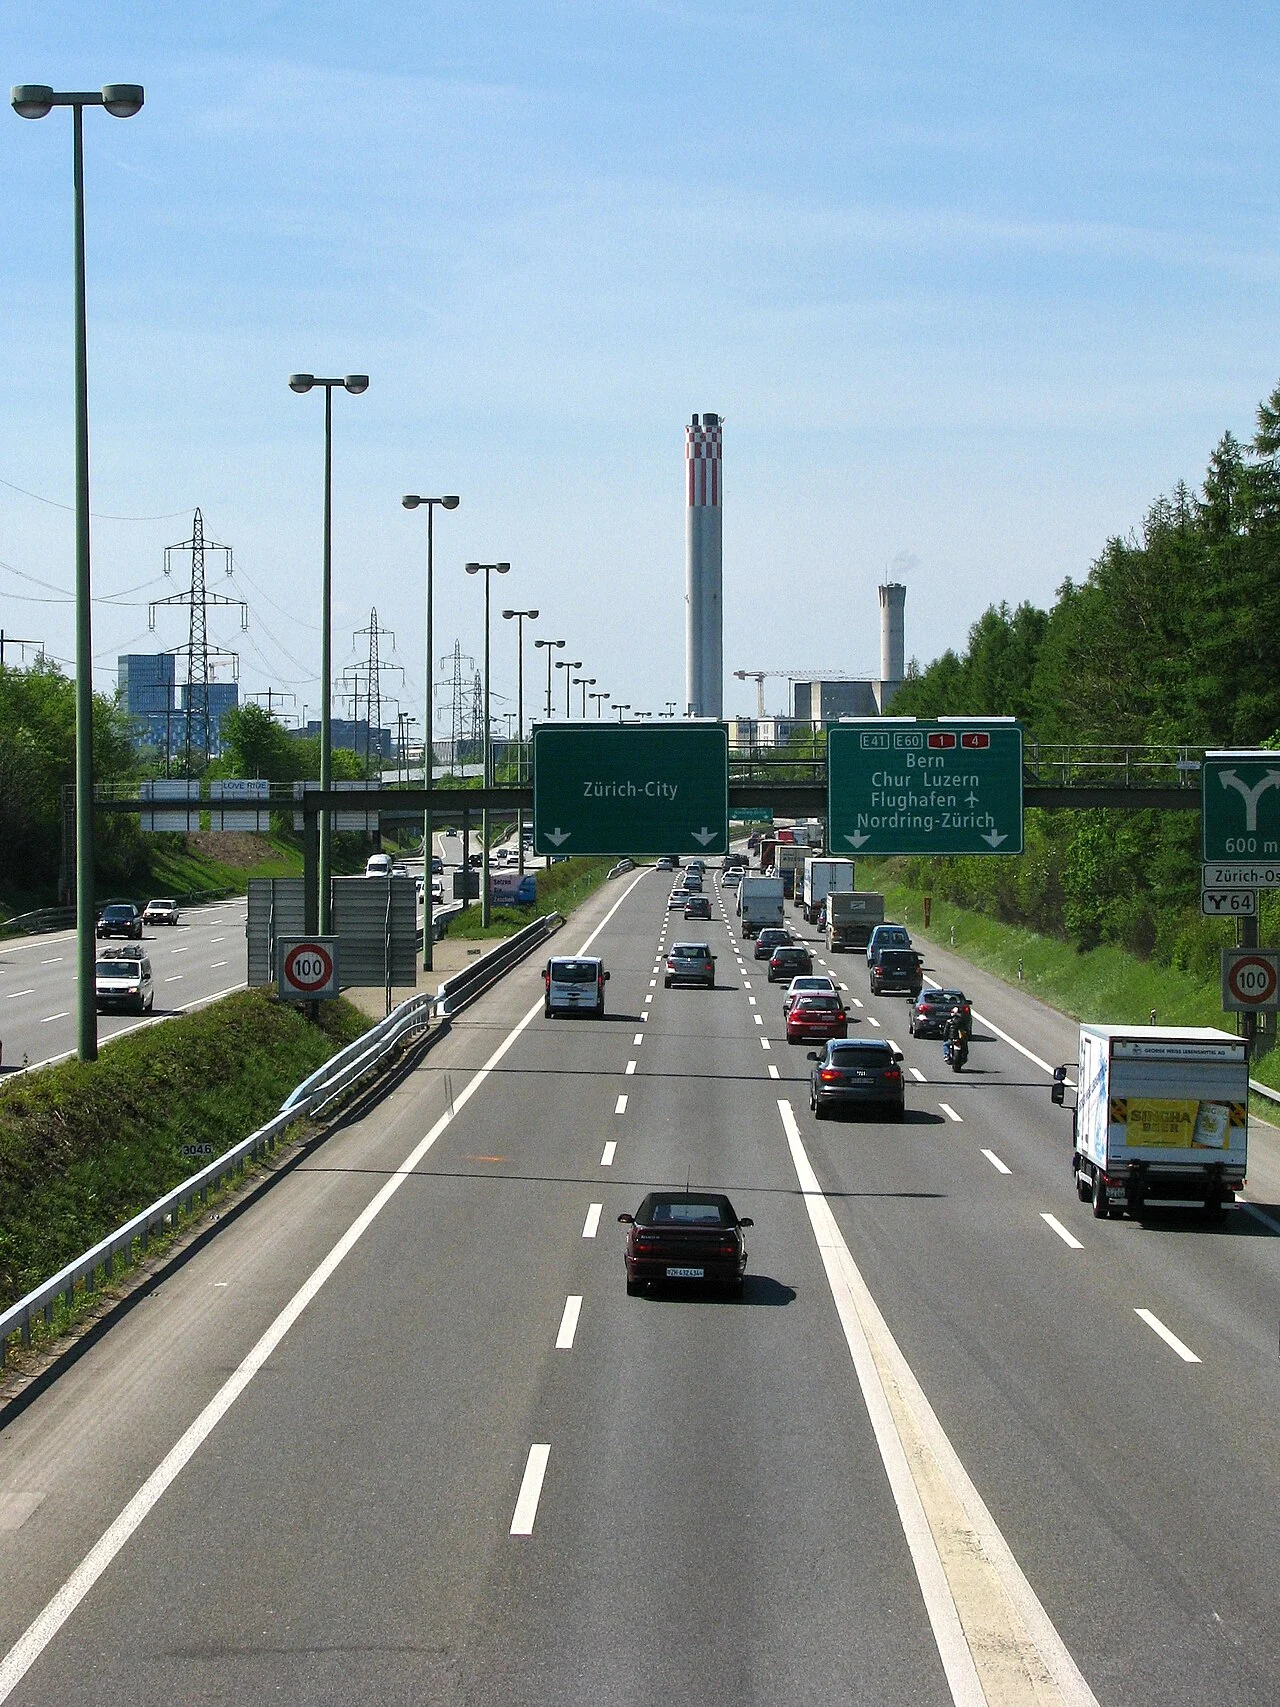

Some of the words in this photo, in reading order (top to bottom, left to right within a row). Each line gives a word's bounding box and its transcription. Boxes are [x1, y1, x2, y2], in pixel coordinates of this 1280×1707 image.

[863, 735, 884, 747] E41
[896, 735, 919, 747] E60
[971, 735, 979, 747] 4
[906, 753, 944, 768] Bern
[223, 781, 245, 790] LOVE
[247, 781, 267, 789] RIDE
[871, 771, 911, 787] Chur
[923, 771, 979, 787] Luzern
[583, 781, 678, 800] Zürich-City
[871, 791, 956, 811] Flughafen
[857, 813, 994, 832] Nordring-Zürich
[1225, 838, 1257, 853] 600
[1264, 840, 1278, 853] m
[1230, 895, 1252, 910] 64
[295, 960, 322, 976] 100
[1239, 972, 1267, 989] 100
